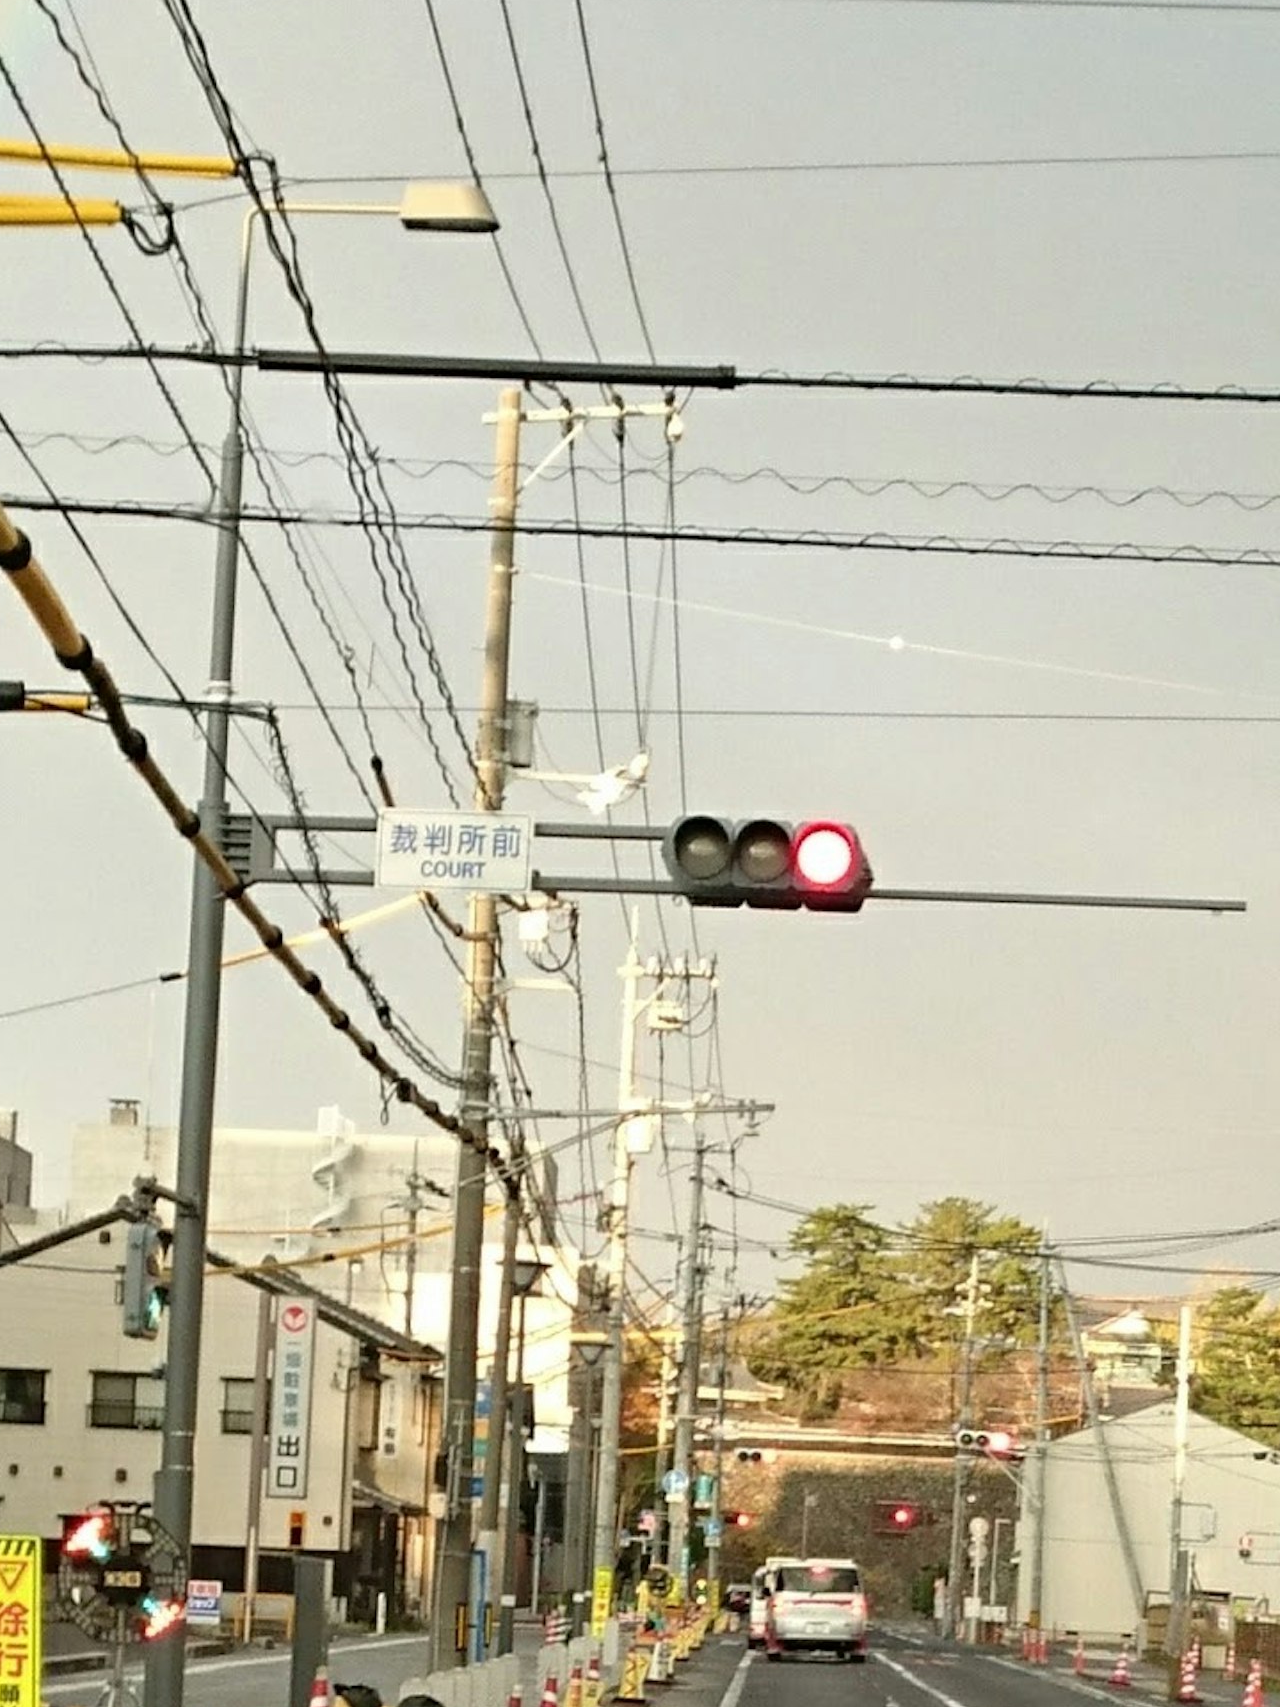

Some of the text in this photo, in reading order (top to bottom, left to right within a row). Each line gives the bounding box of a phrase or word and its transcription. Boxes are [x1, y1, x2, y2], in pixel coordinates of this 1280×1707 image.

[391, 823, 521, 858] 裁判所前
[421, 860, 486, 878] COURT
